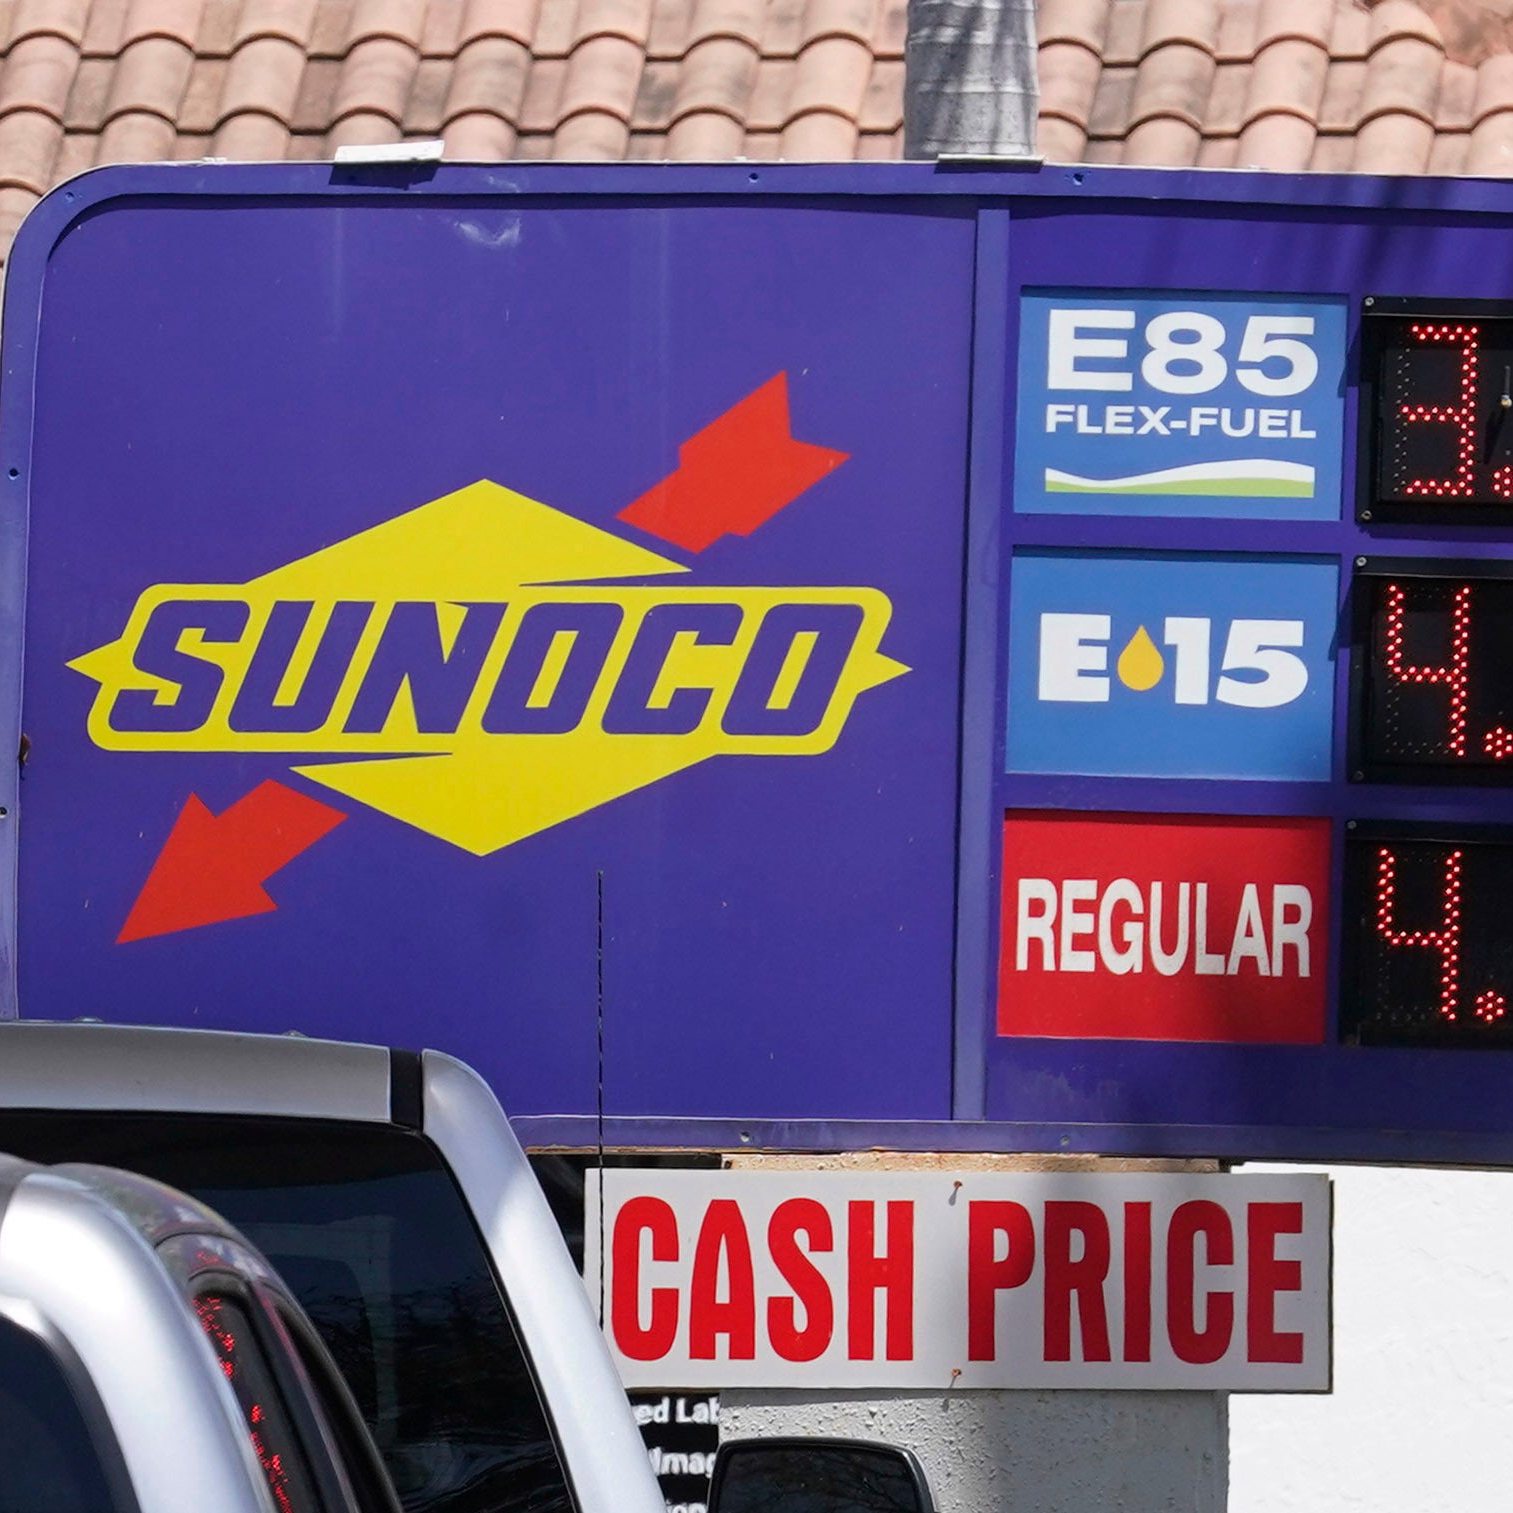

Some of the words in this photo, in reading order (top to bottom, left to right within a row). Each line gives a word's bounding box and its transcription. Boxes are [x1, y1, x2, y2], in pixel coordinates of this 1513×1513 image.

[1047, 308, 1319, 397] E85
[1045, 403, 1317, 439] FLEX-FUEL
[107, 599, 865, 737] SUNOCO
[1016, 878, 1312, 977] REGULAR
[611, 1196, 915, 1363] CASH
[968, 1200, 1305, 1366] PRICE
